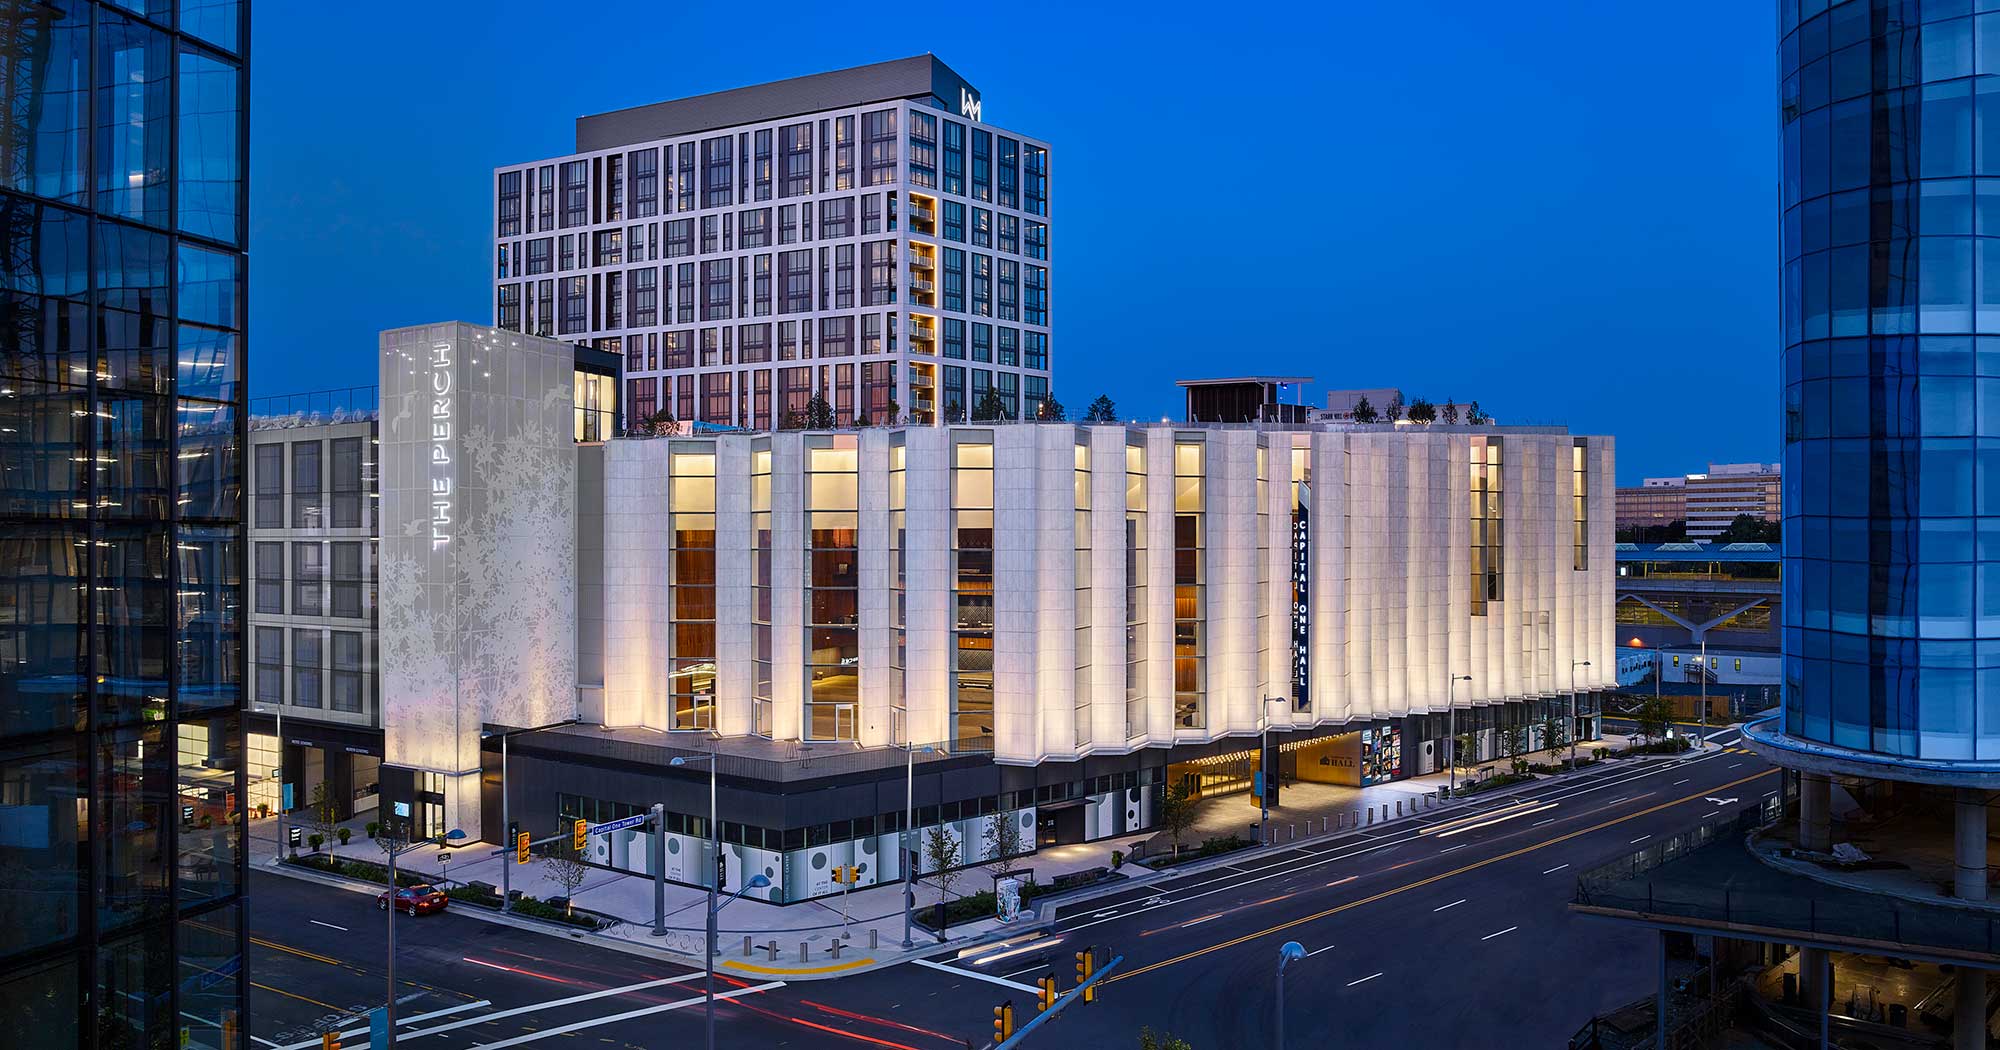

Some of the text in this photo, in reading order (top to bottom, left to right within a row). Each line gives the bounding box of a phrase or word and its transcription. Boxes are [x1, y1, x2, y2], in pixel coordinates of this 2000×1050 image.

[432, 343, 451, 551] THE PERCH
[1299, 520, 1307, 687] CAPITAL ONE HALL
[1331, 759, 1356, 768] HALL
[595, 825, 611, 833] Capital
